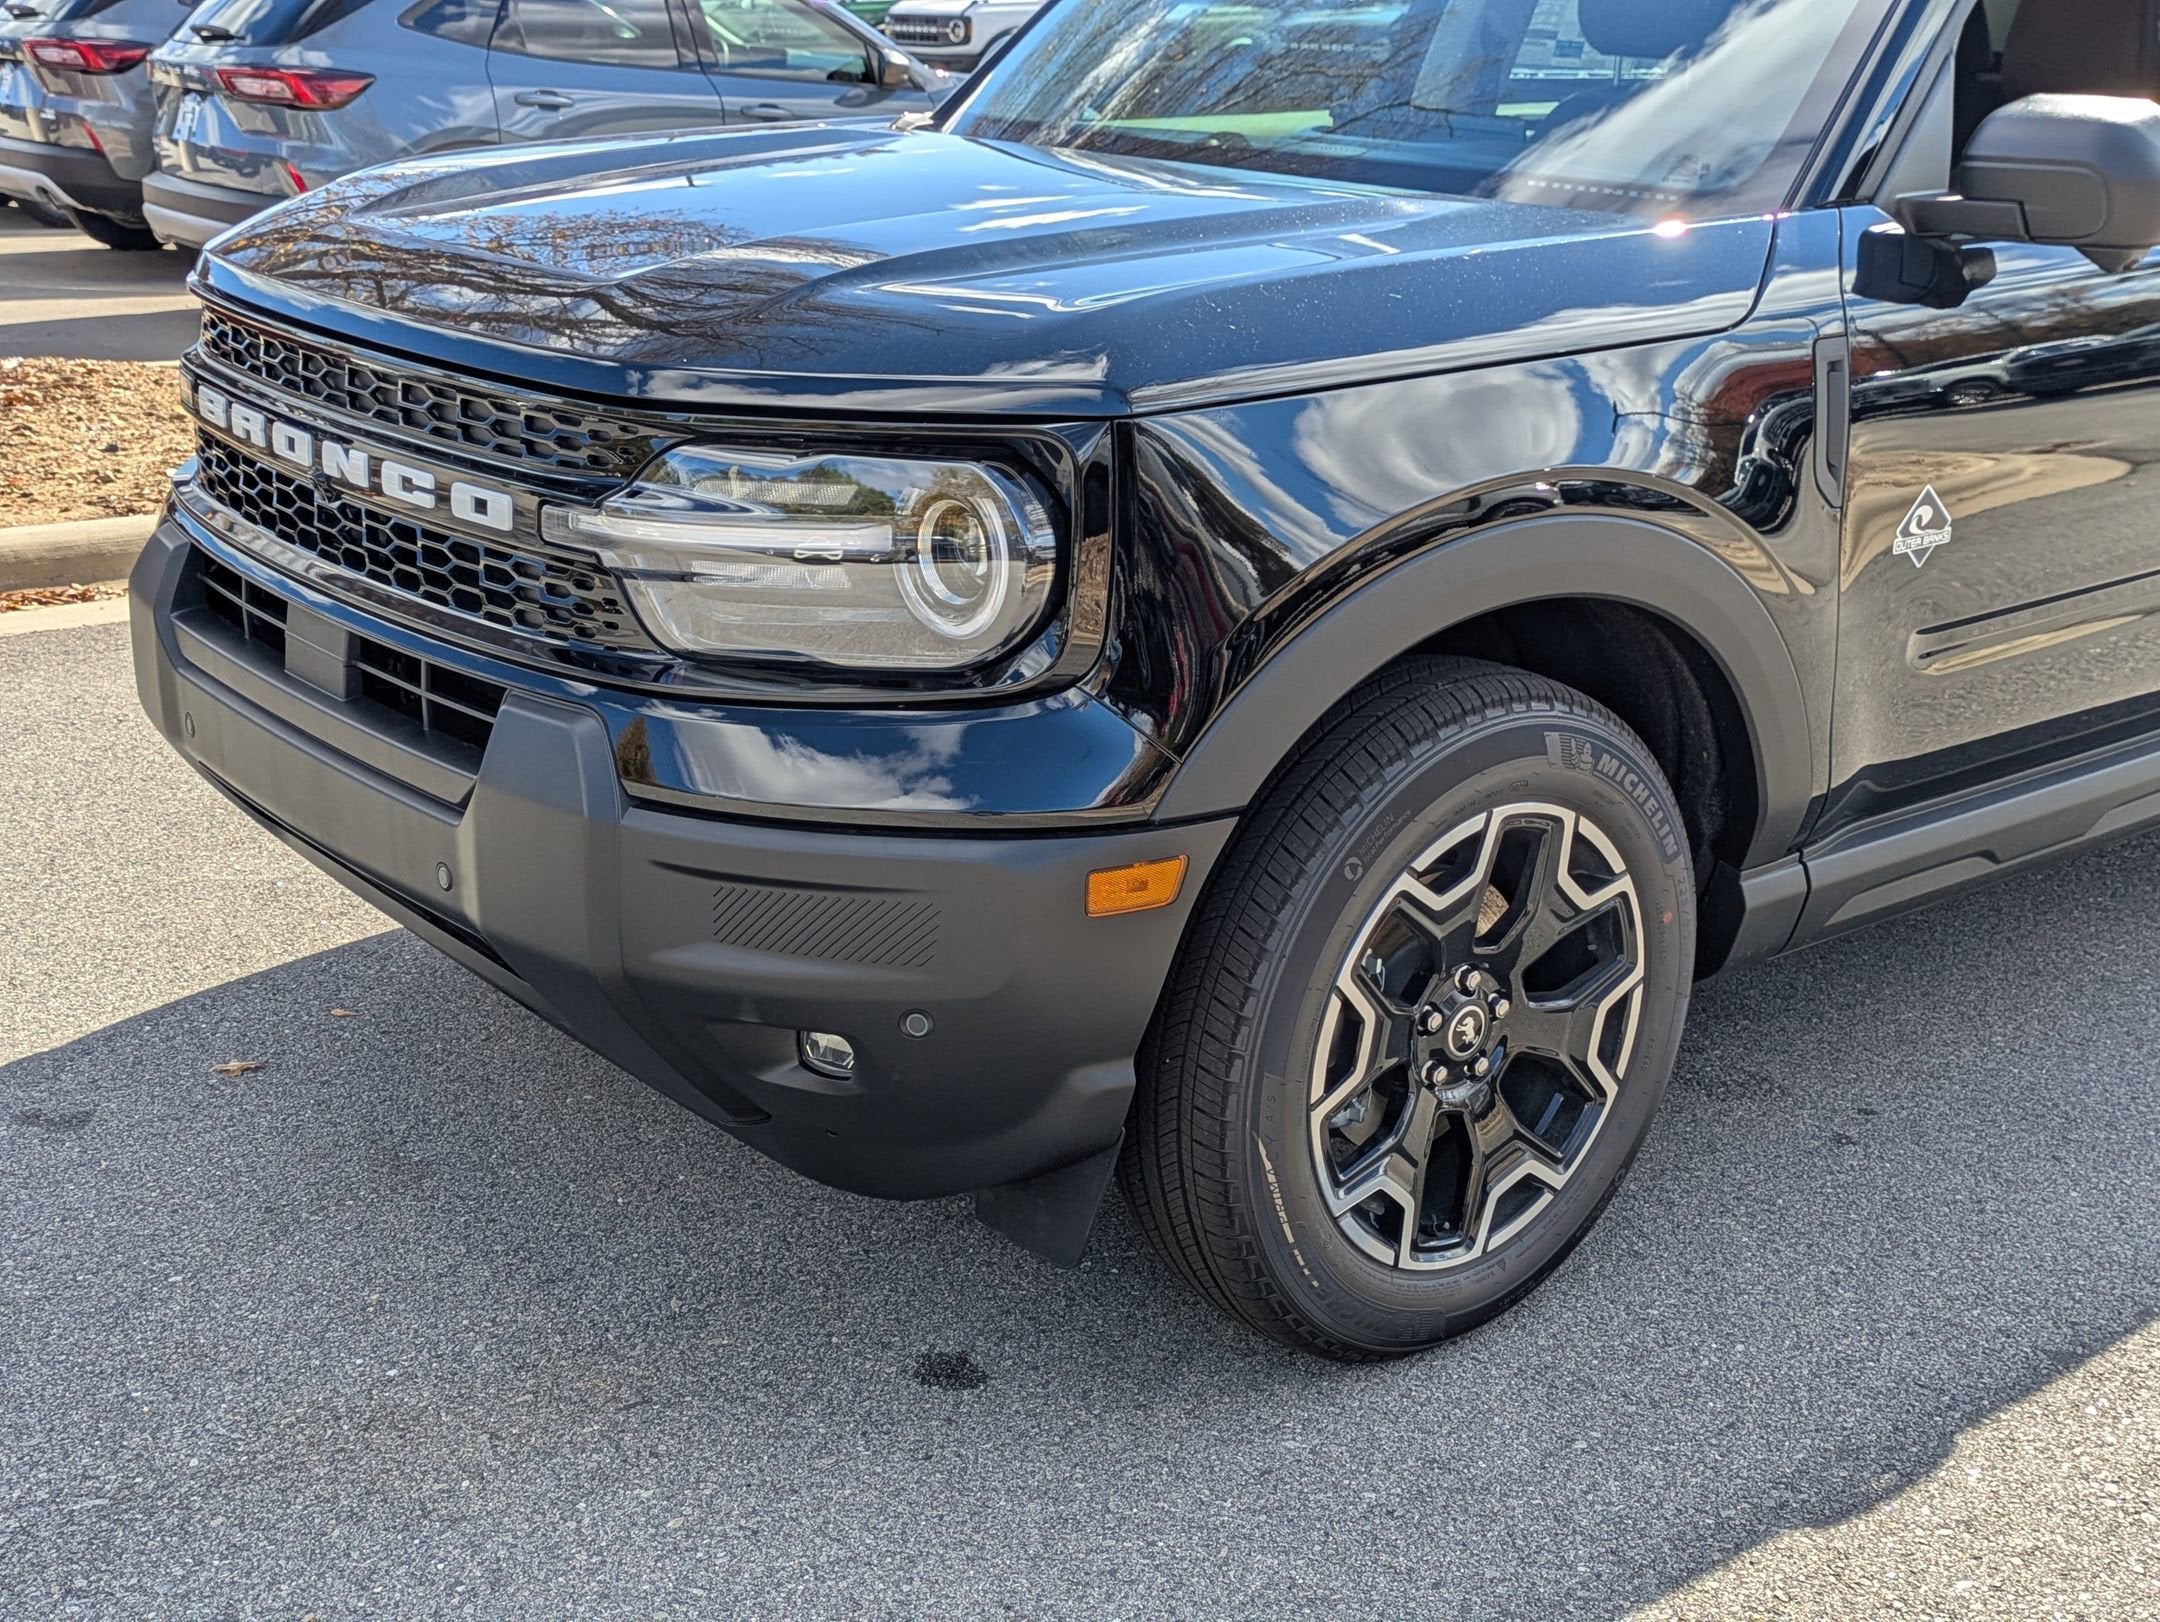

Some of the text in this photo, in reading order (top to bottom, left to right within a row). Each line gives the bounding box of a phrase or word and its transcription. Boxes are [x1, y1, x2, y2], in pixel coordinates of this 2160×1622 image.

[198, 384, 514, 532] BRONCO
[1896, 531, 1949, 551] OUTER BANKS
[1597, 753, 1678, 857] MICHELIN
